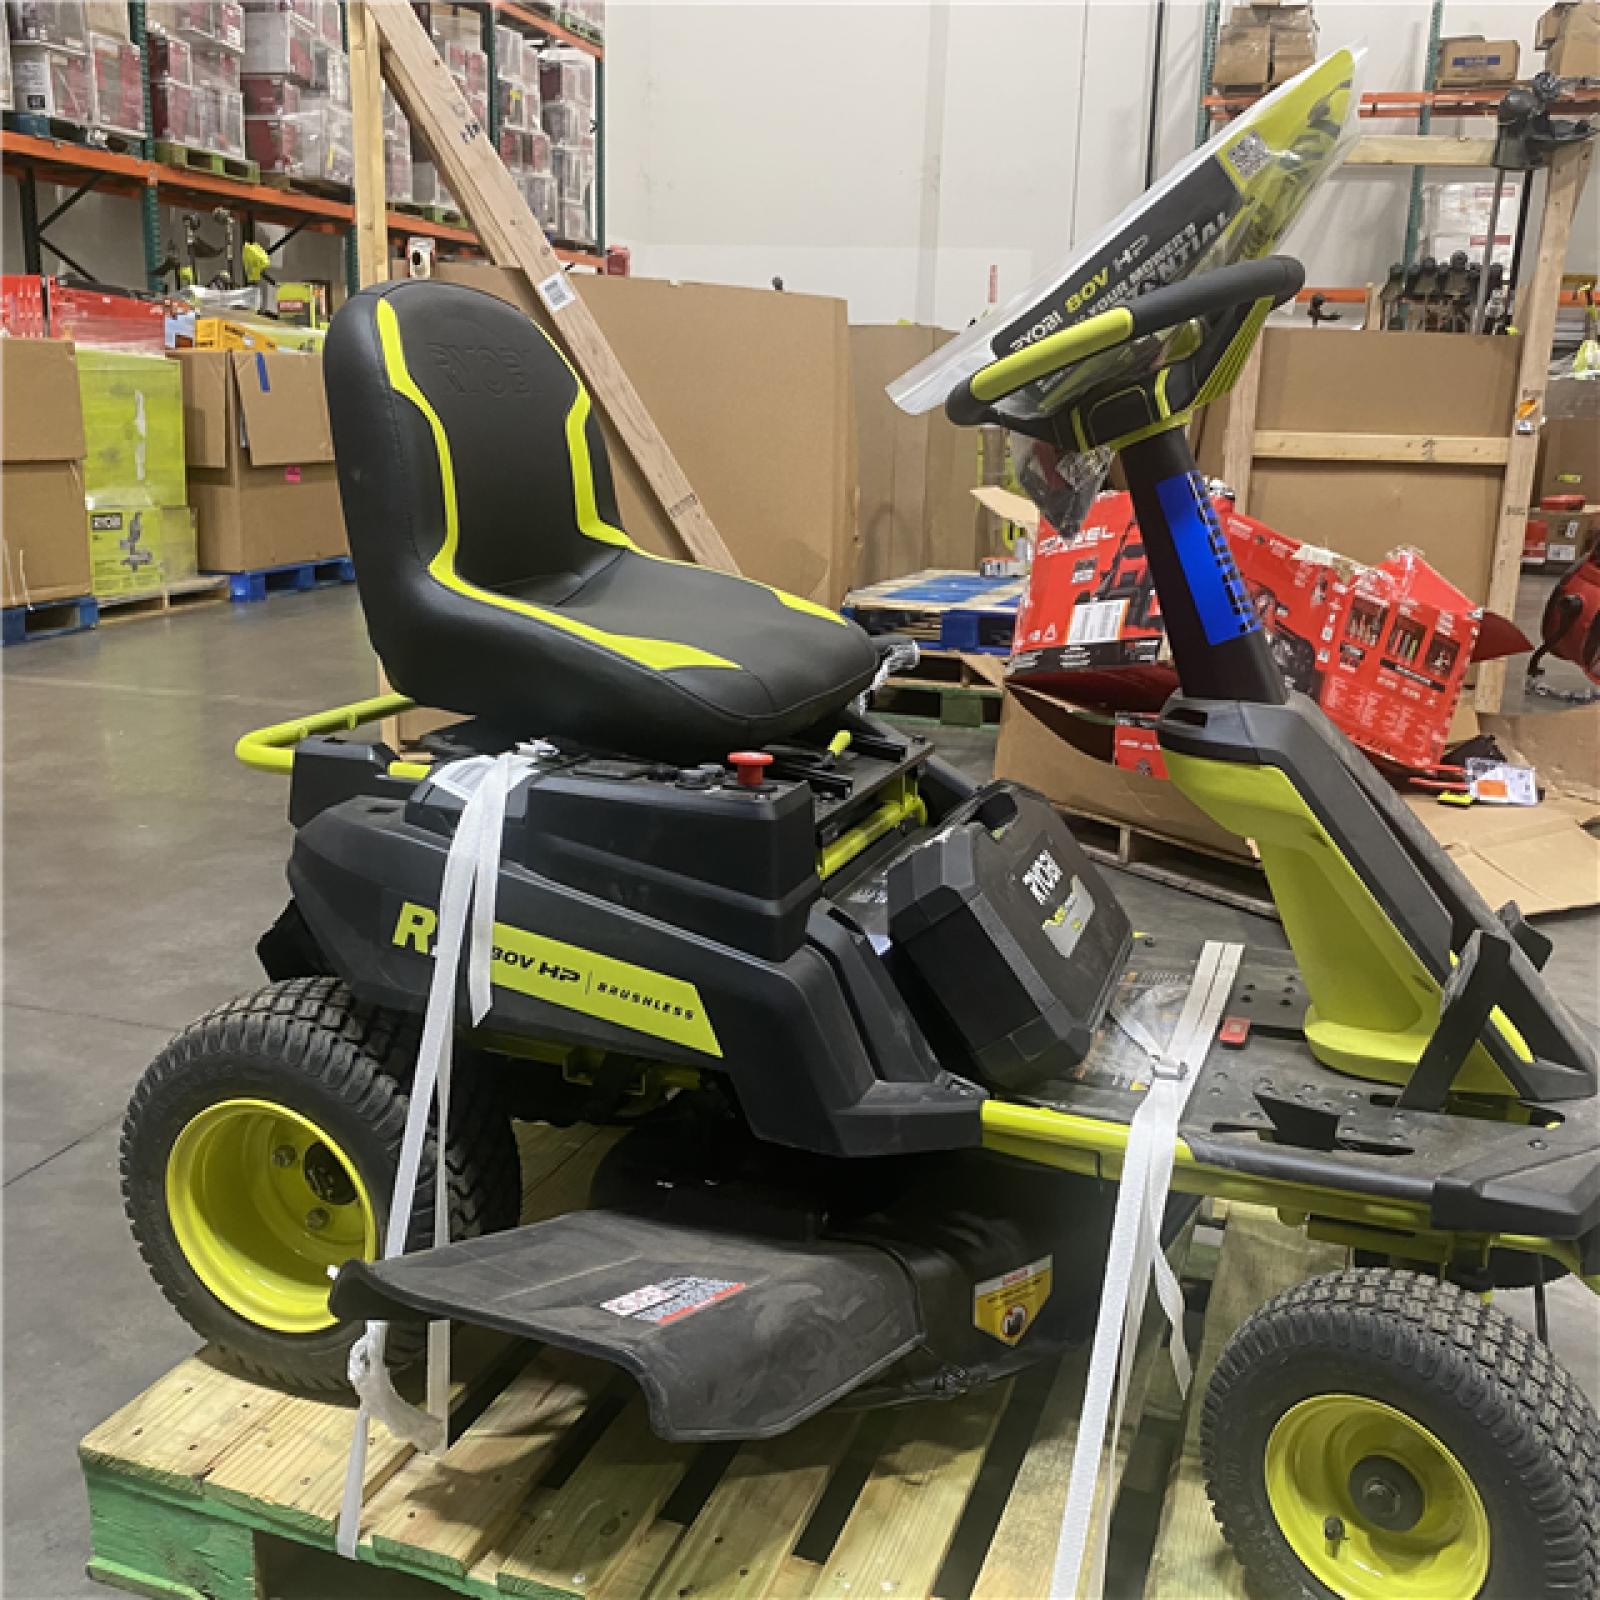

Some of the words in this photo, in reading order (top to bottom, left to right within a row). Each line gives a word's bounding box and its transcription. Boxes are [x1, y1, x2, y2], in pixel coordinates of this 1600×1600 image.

[1065, 266, 1109, 313] 80V
[1113, 234, 1150, 273] HP
[1022, 849, 1063, 905] RYOBI
[537, 960, 581, 983] HP
[597, 981, 695, 1021] BRUSHLESS
